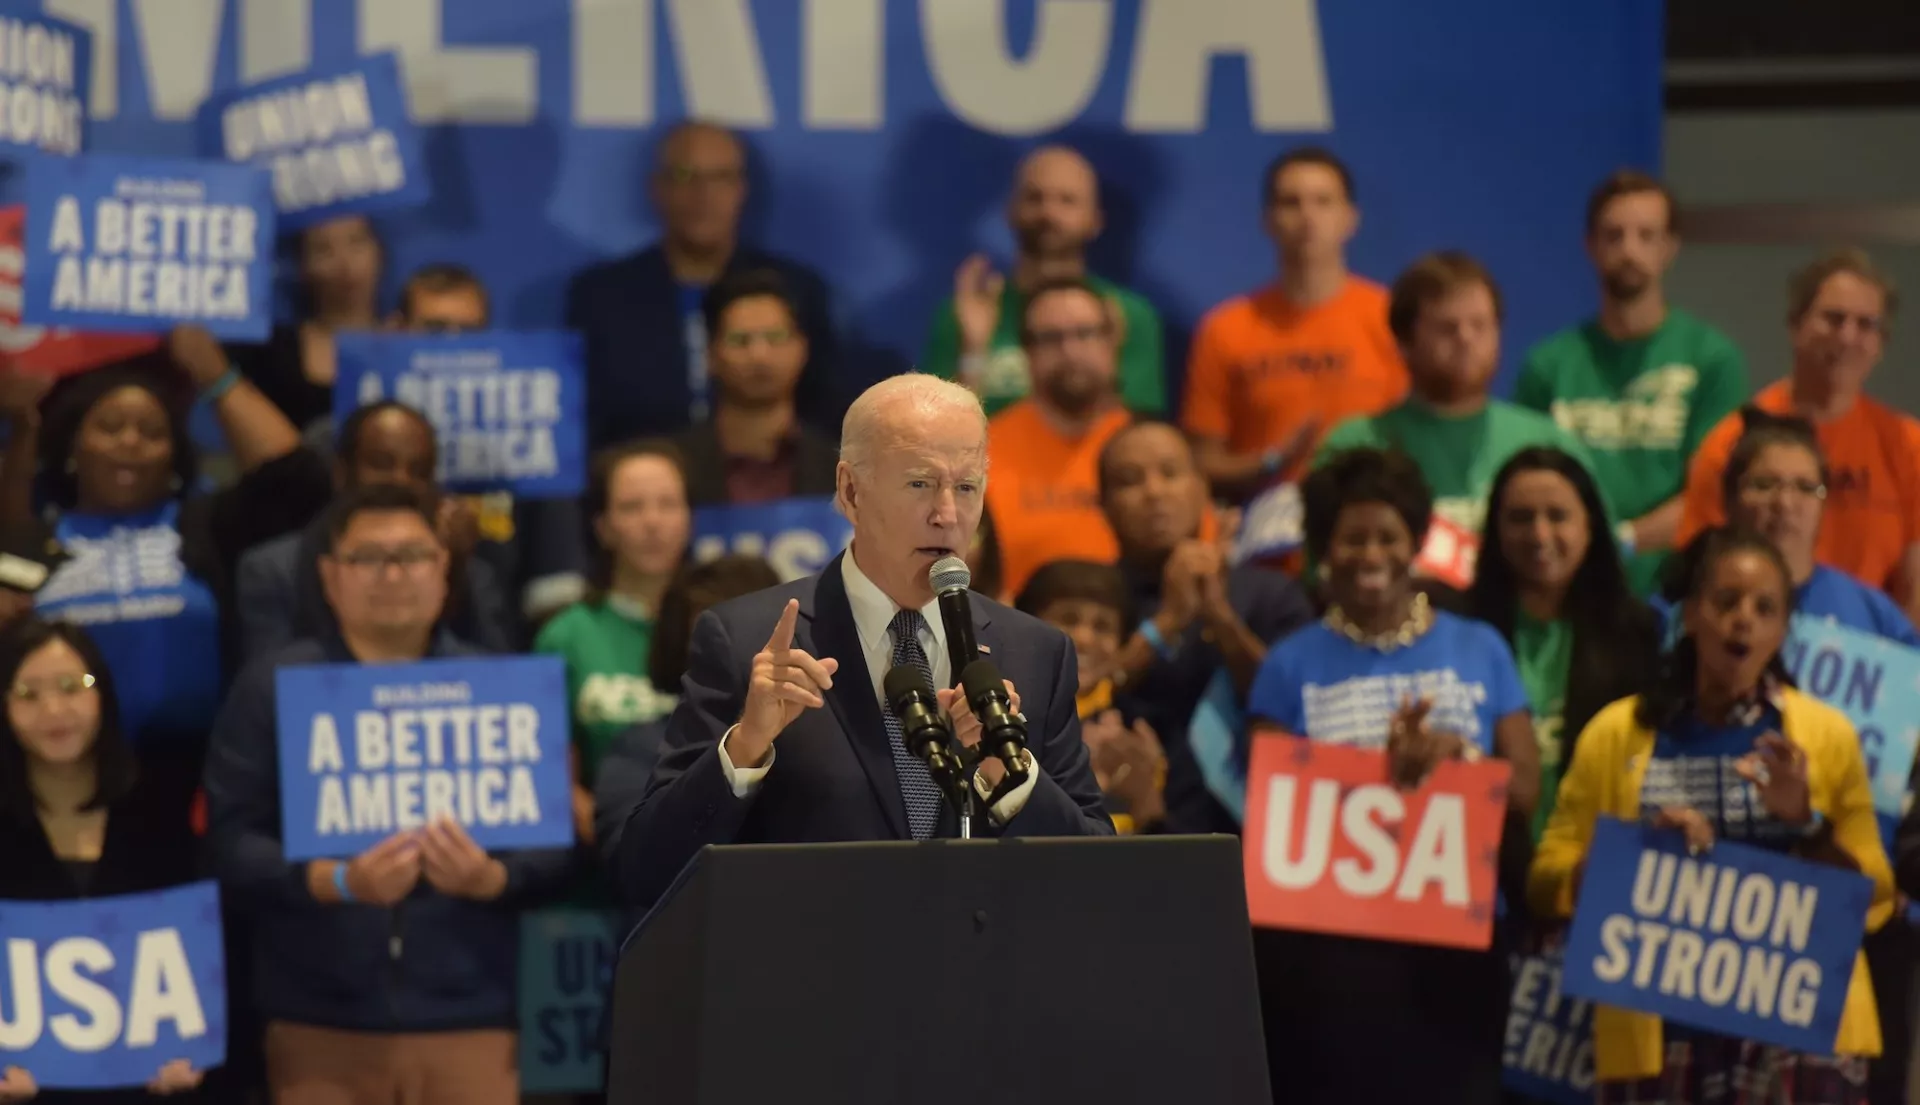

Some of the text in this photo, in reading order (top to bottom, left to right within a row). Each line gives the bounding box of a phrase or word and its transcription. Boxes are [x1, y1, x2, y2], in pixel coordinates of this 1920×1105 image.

[0, 15, 75, 90] ION
[0, 80, 83, 157] ONG
[48, 194, 259, 261] A BETTER
[50, 253, 251, 320] AMERICA
[308, 702, 542, 774] A BETTER
[316, 765, 541, 836] AMERICA
[1261, 772, 1470, 907] USA
[1631, 848, 1818, 951] UNION
[1592, 914, 1823, 1029] STRONG
